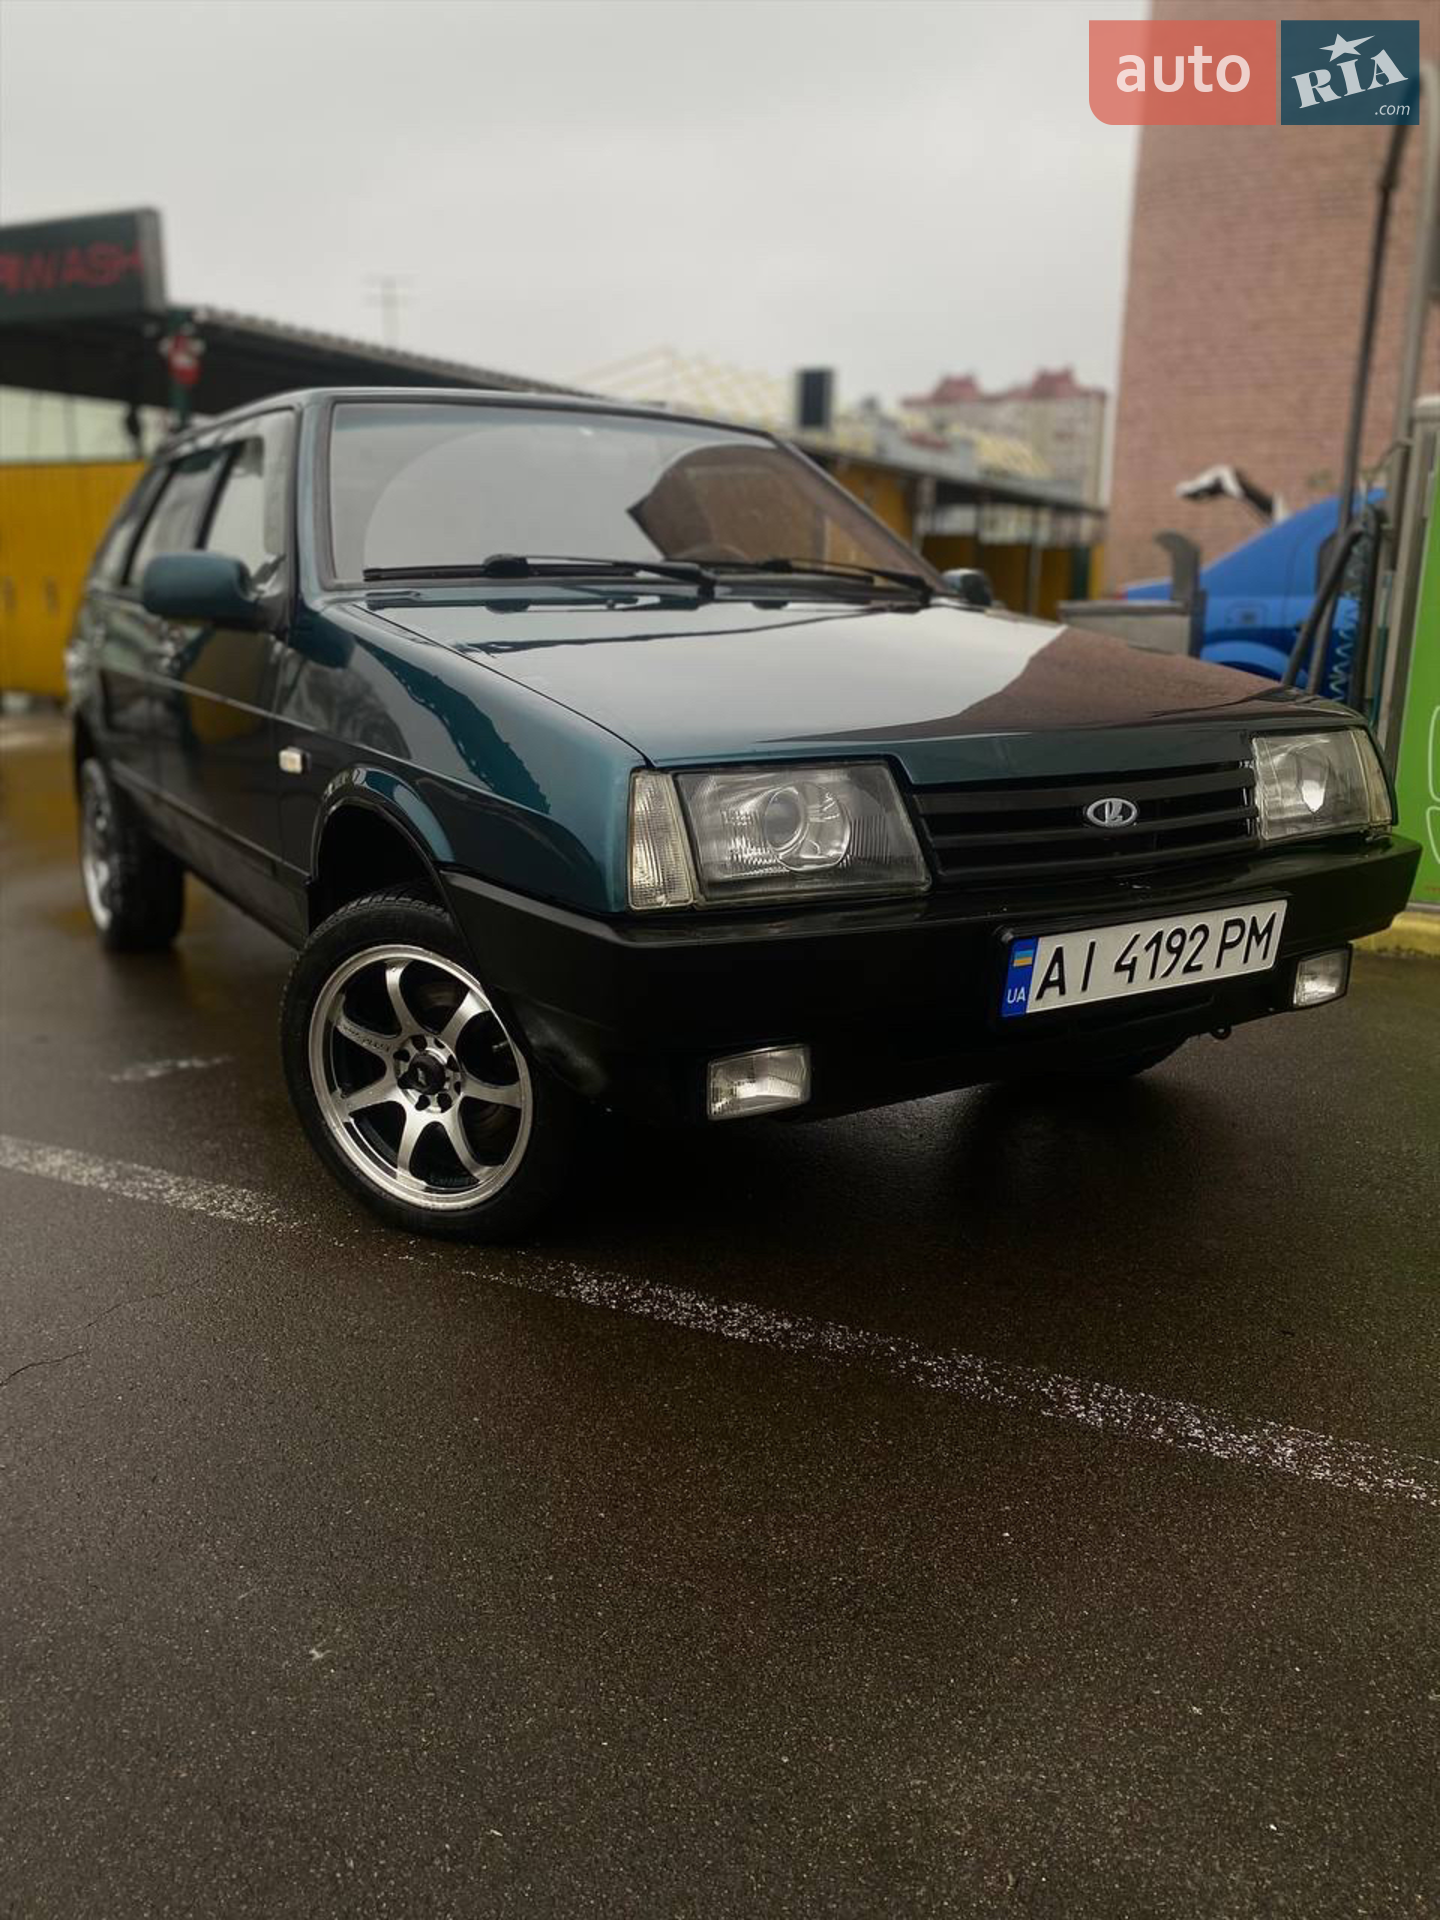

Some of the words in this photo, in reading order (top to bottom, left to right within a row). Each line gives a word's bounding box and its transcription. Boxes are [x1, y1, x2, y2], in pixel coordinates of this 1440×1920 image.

[1035, 940, 1096, 1001] AI
[1113, 923, 1210, 984] 4192
[1215, 911, 1277, 969] PM
[1007, 988, 1026, 1004] UA
